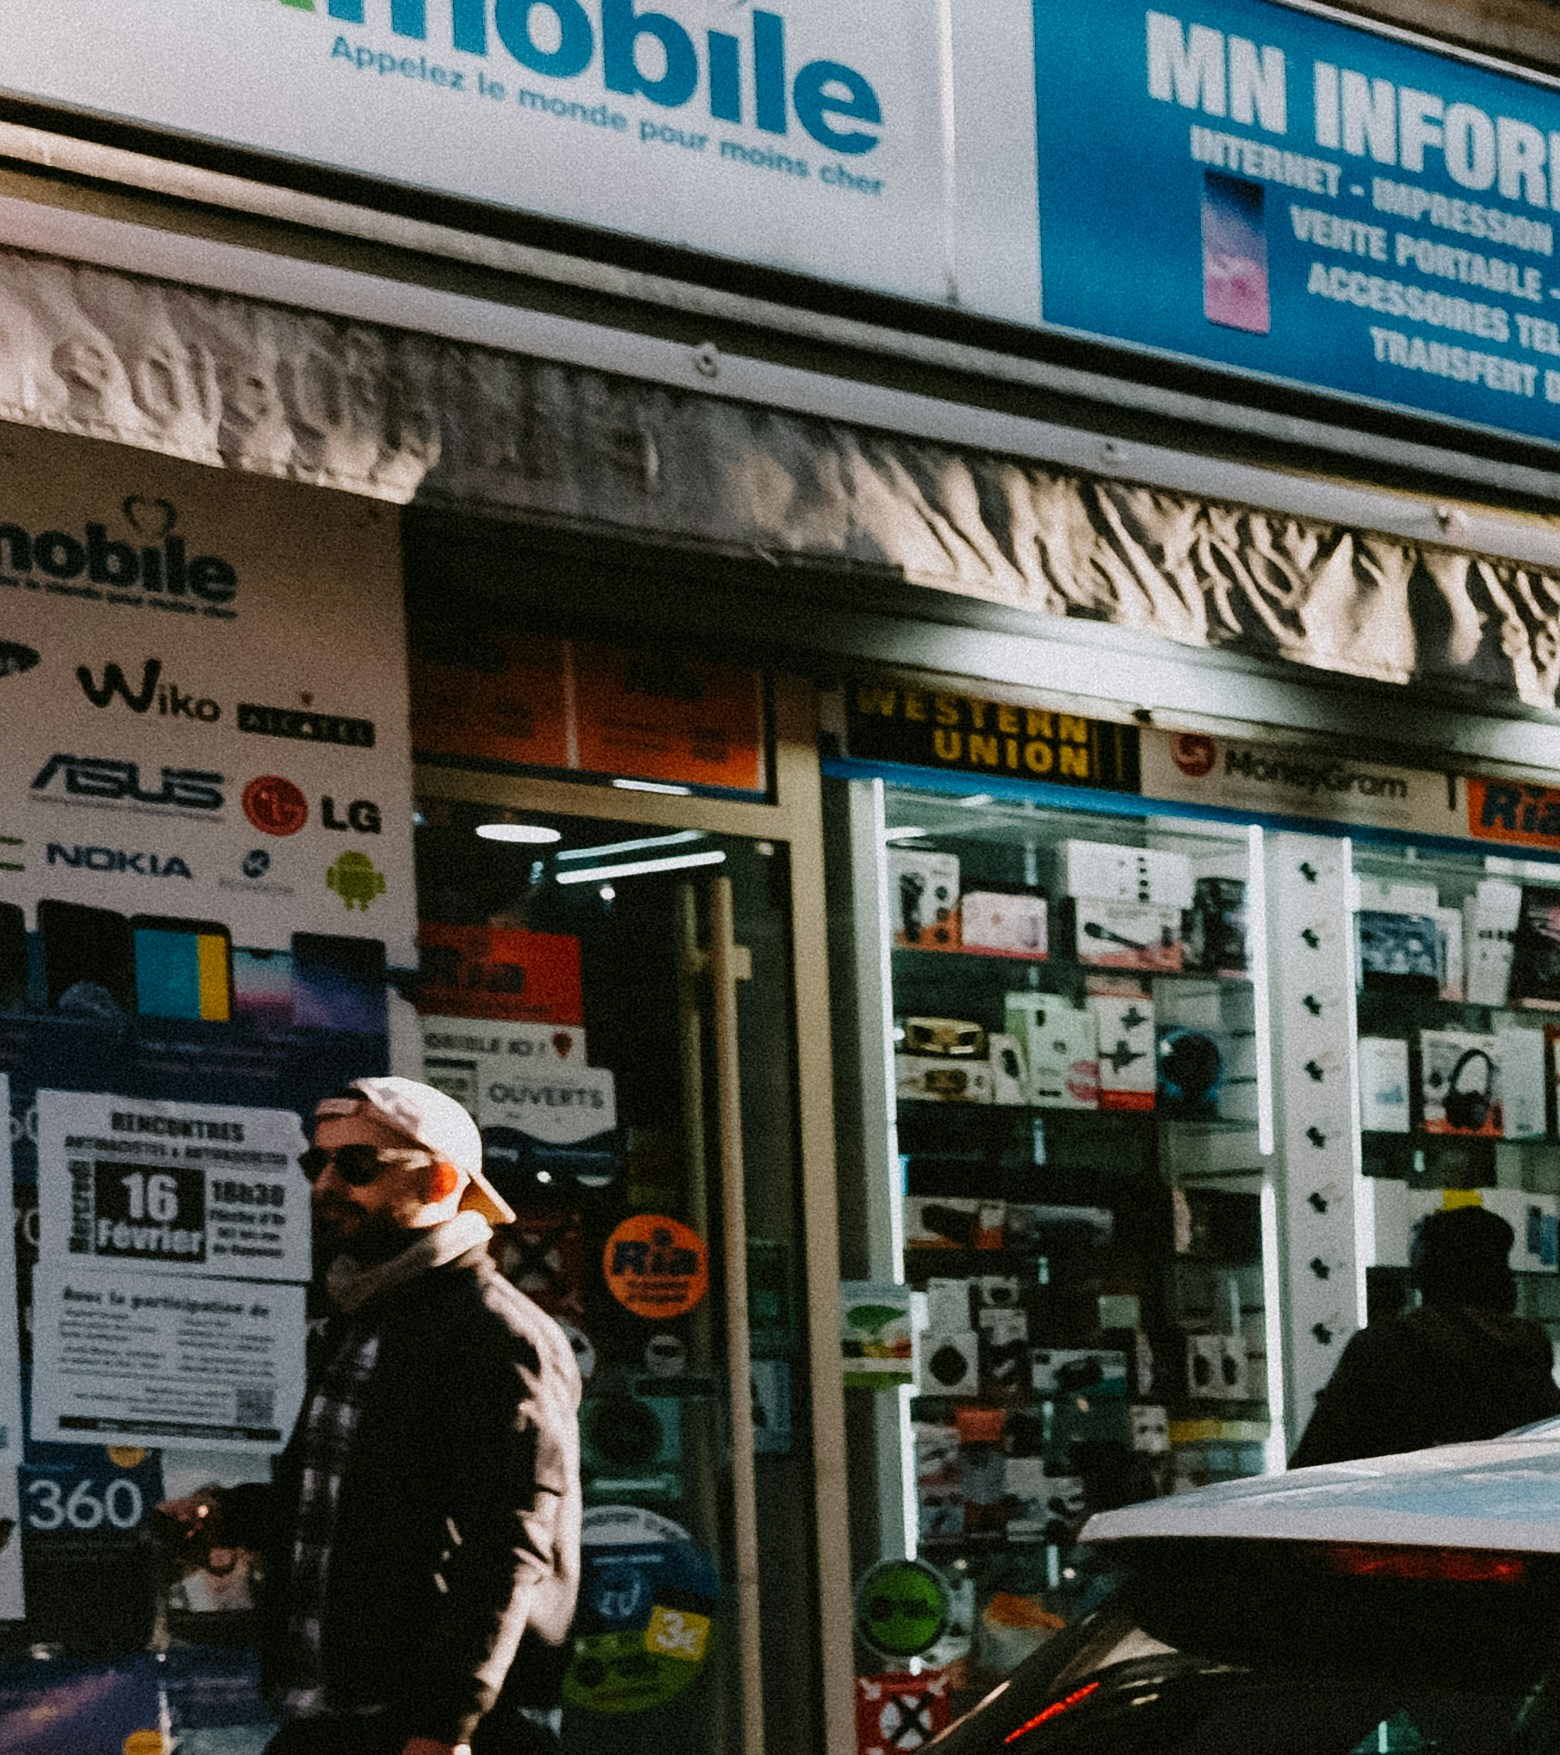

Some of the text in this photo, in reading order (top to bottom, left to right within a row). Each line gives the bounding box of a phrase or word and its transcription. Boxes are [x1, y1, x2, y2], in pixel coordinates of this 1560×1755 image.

[1146, 10, 1288, 135] MN
[331, 37, 883, 197] Appelez le monde pour moins cher
[1189, 126, 1342, 198] INTERNET
[1372, 177, 1554, 257] IMPRESSION
[1290, 205, 1388, 262] VENTE
[1396, 232, 1543, 303] PORTABLE
[1307, 262, 1511, 341] ACCESSOIRES
[1369, 327, 1538, 397] TRANSFERT
[76, 658, 221, 723] Wiko
[857, 687, 1088, 744] WESTERN
[933, 728, 1088, 779] UNION
[1225, 749, 1408, 800] MoneyGram
[31, 753, 225, 809] ASUS
[321, 796, 382, 834] LG
[46, 843, 193, 880] NOKIA
[121, 1170, 179, 1224] 16
[97, 1215, 205, 1257] Février
[612, 1225, 698, 1276] Ria
[26, 1478, 143, 1529] 360
